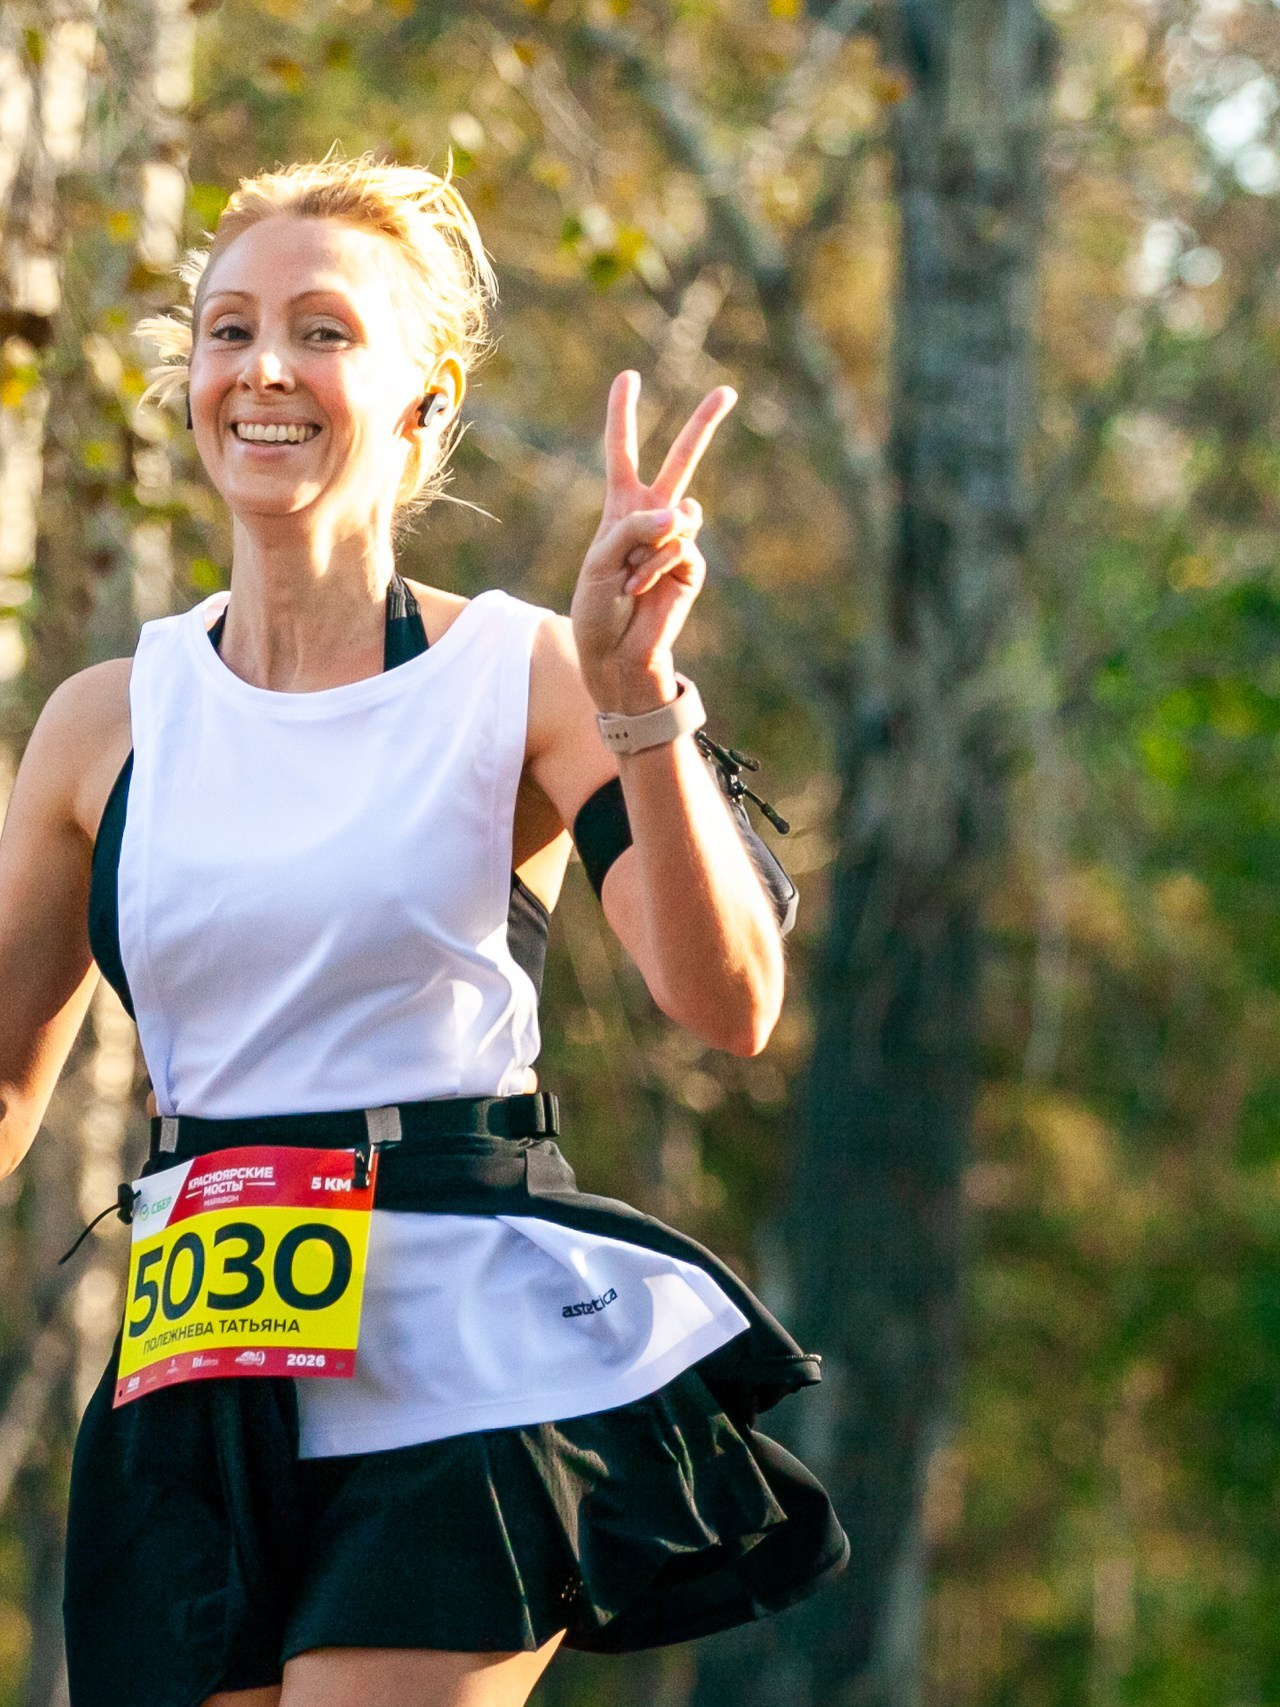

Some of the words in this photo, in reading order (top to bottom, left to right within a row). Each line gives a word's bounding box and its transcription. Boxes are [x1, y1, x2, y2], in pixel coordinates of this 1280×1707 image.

[188, 1166, 274, 1191] КРАСНОЯРСКИЕ
[203, 1180, 243, 1197] МОСТЫ
[311, 1176, 322, 1190] 5
[324, 1177, 352, 1192] КМ
[128, 1222, 352, 1337] 5030
[562, 1288, 618, 1318] astetica
[143, 1321, 214, 1353] ПОЛЕЖНЕВА
[219, 1319, 300, 1333] ТАТЬЯНА
[286, 1354, 326, 1367] 2026
